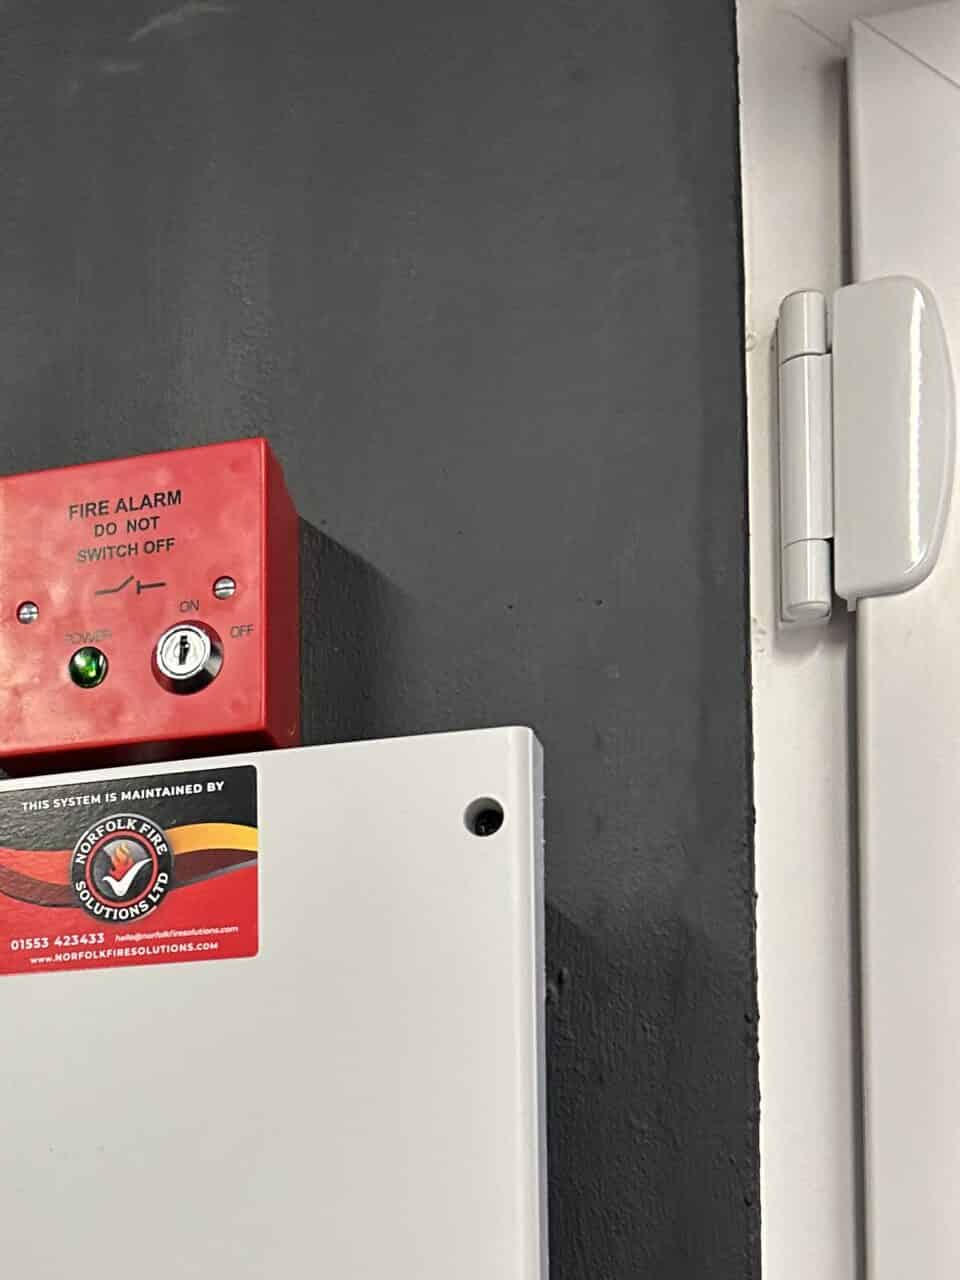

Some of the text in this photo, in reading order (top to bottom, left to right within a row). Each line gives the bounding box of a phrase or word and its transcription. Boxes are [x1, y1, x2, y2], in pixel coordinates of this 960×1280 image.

[69, 490, 182, 520] FIRE ALARM
[94, 517, 160, 537] DO NOT
[78, 538, 175, 562] SWITCH OFF
[179, 600, 200, 612] ON
[231, 624, 254, 638] OFF
[23, 781, 224, 812] THIS SYSTEM IS MAINTAINED BY
[76, 818, 168, 864] NORFOLK FIRE
[76, 872, 169, 920] SOLUTIONS LTD
[11, 933, 104, 951] 01553 423433
[29, 942, 219, 964] www.NORFOLKFIRESOLUTIONS.COM
